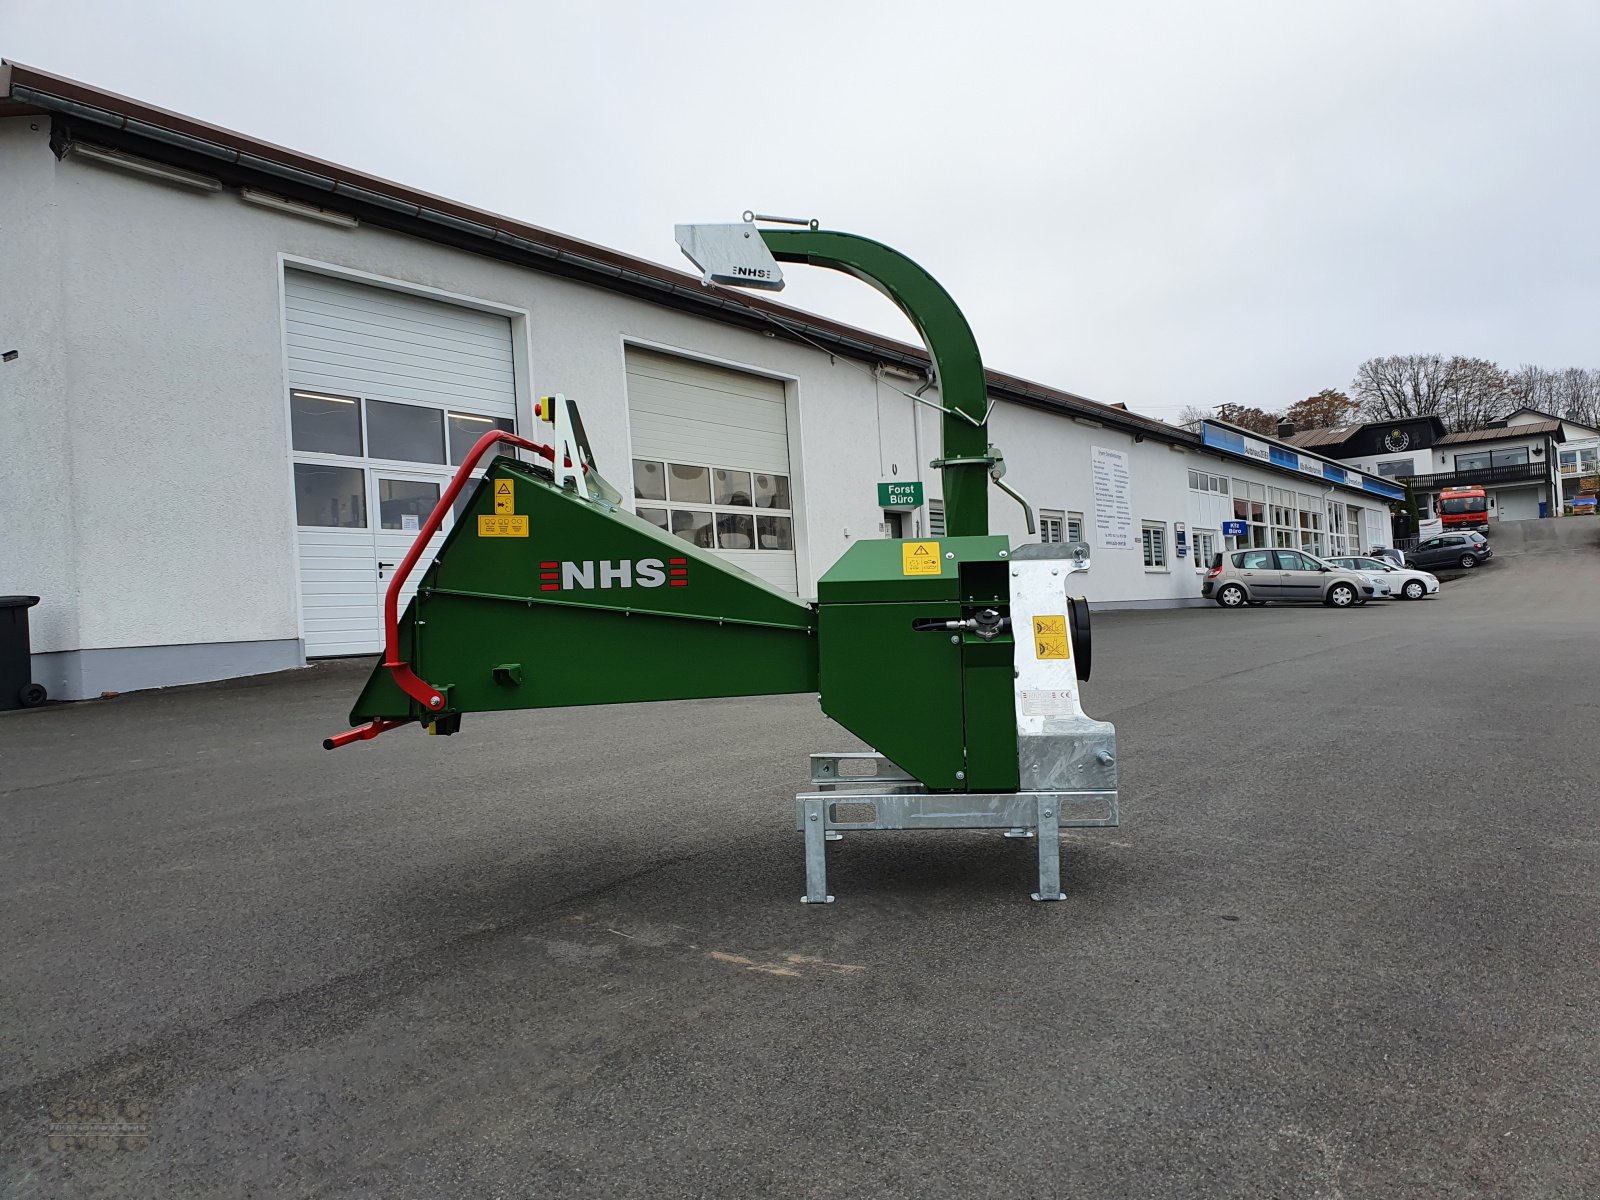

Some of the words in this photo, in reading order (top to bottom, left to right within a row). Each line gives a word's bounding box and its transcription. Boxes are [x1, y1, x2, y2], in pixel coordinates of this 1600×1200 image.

[738, 267, 765, 278] NHS
[888, 485, 915, 494] Forst
[890, 495, 914, 504] Büro
[561, 558, 667, 590] NHS
